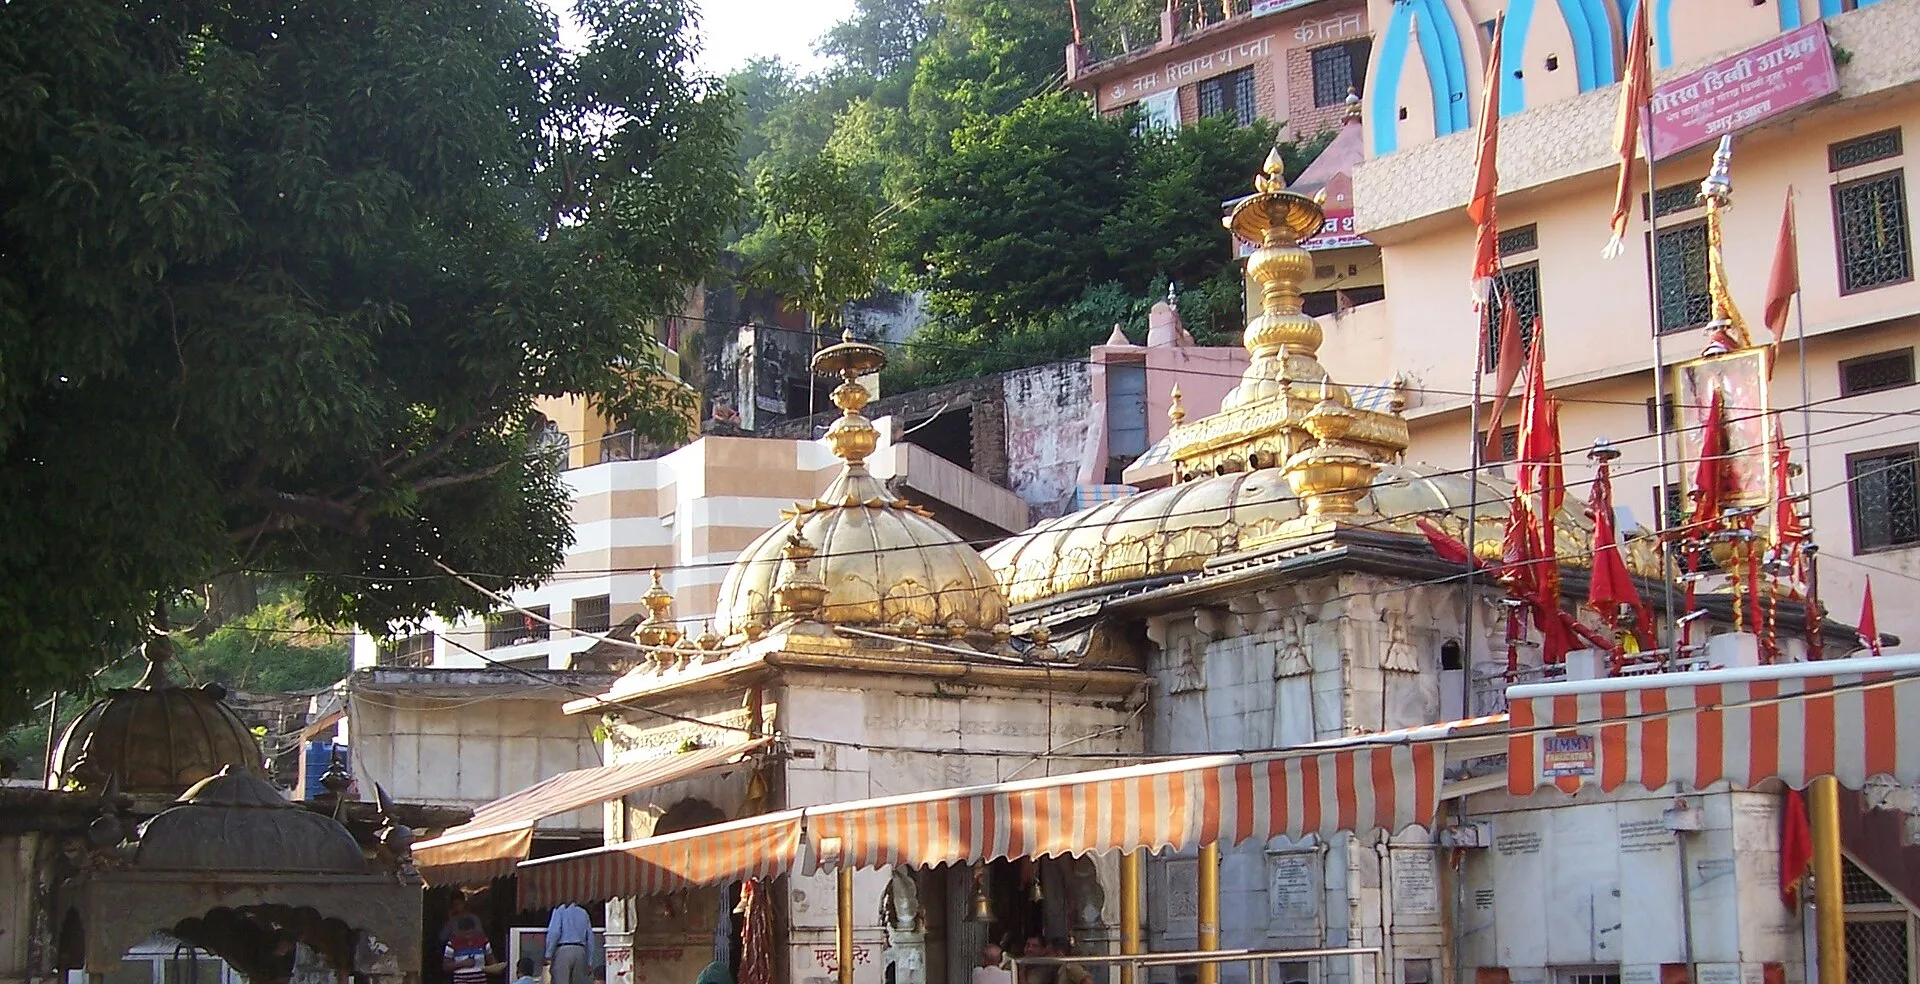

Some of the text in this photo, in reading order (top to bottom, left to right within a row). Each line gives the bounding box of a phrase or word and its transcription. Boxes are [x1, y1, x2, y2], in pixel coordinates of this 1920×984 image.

[1132, 72, 1160, 91] नमः
[1165, 53, 1216, 84] शिवाय
[1757, 34, 1817, 72] आश्रम
[1546, 736, 1591, 752] JIMMY
